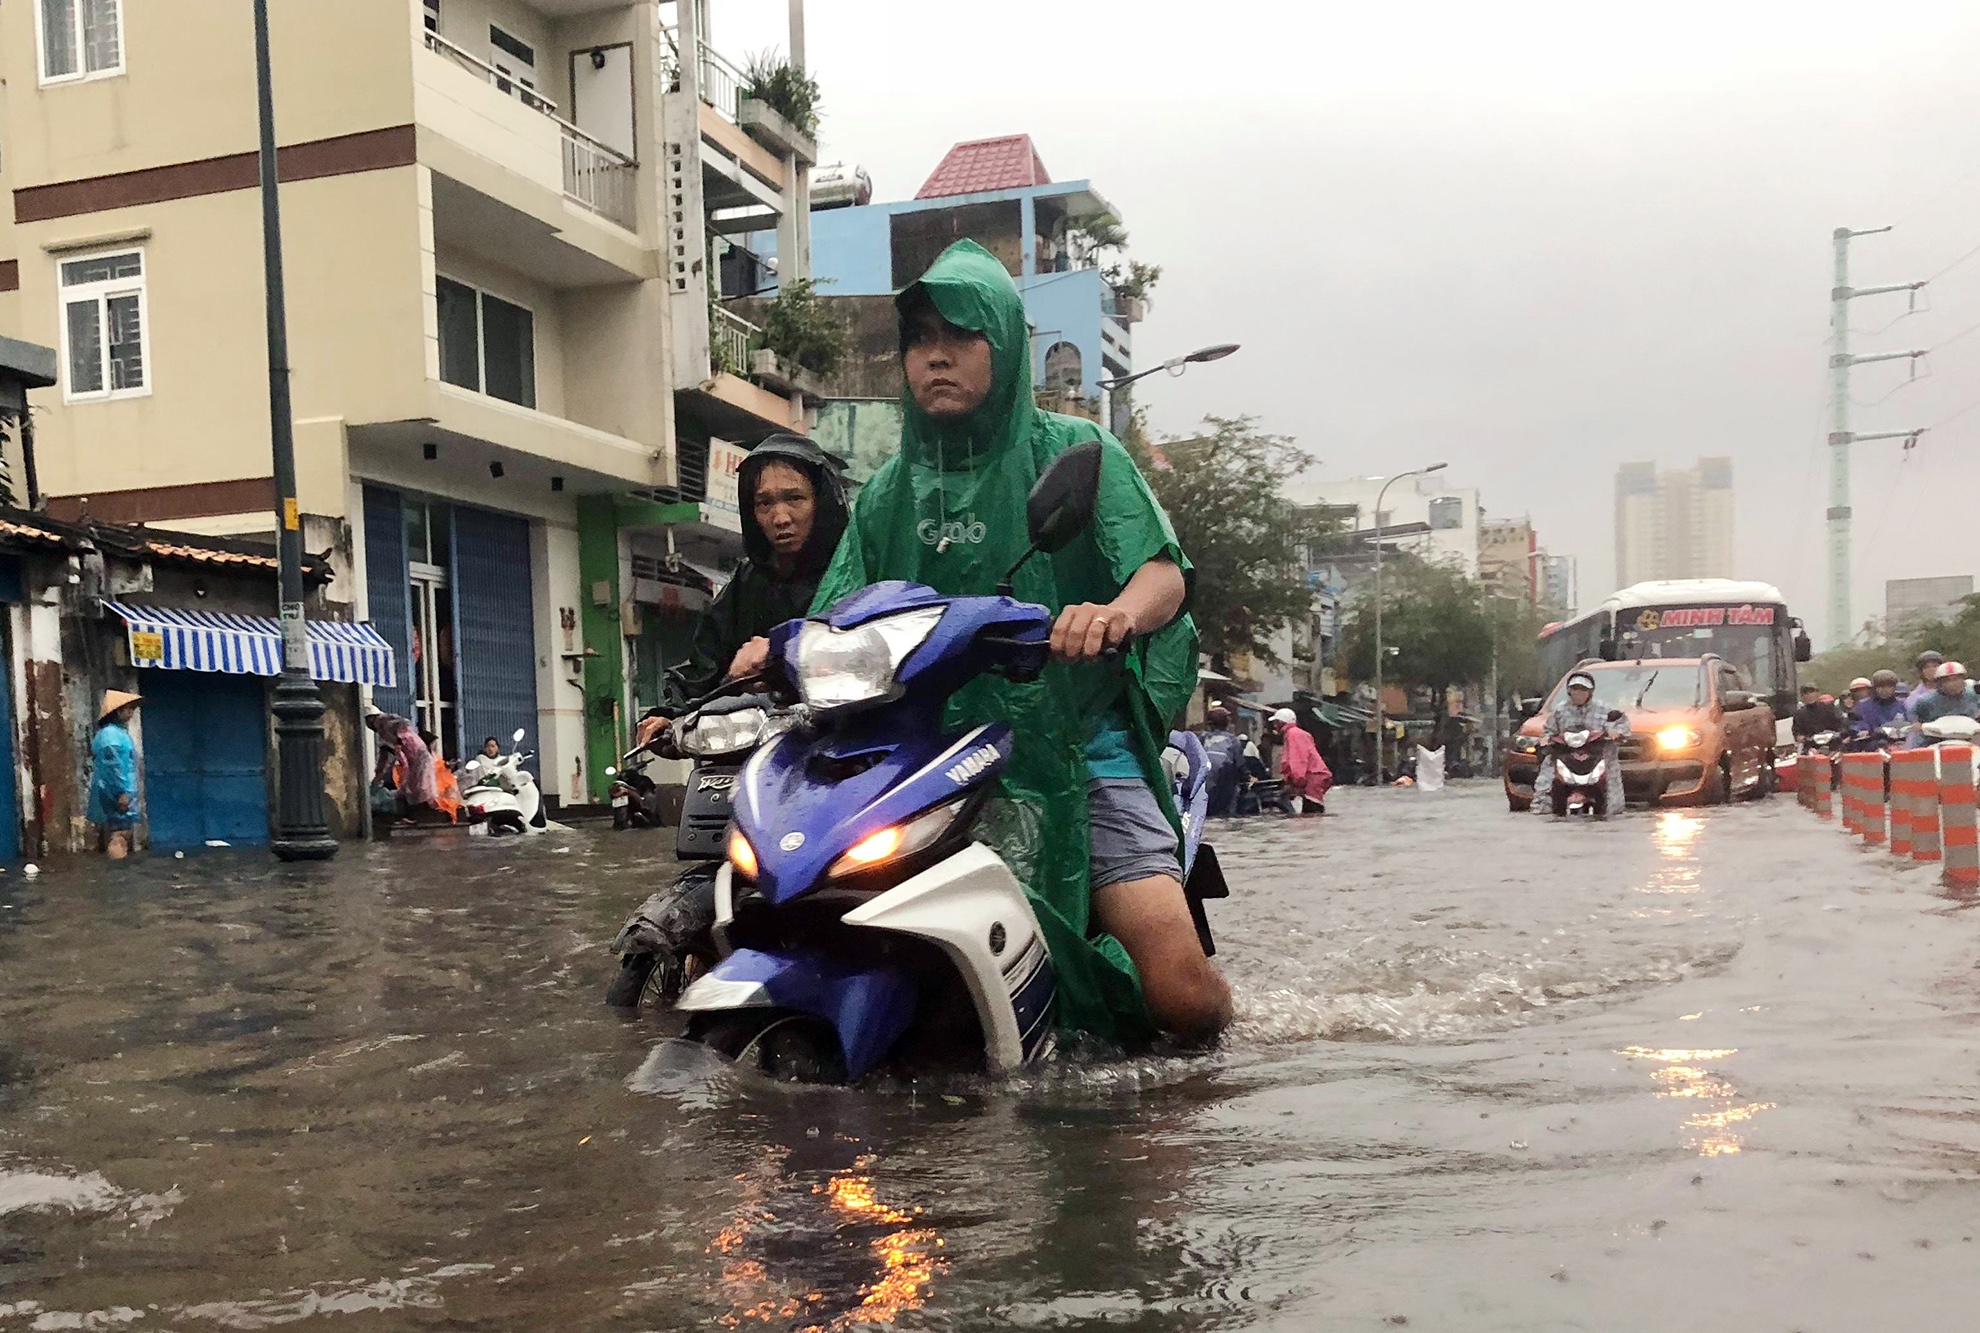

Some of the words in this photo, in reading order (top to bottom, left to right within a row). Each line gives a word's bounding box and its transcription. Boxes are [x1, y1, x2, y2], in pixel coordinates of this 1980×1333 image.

[917, 513, 985, 545] Grab
[1661, 609, 1725, 627] MINH
[1727, 604, 1774, 625] TÂM
[945, 743, 1001, 786] YAMAHA
